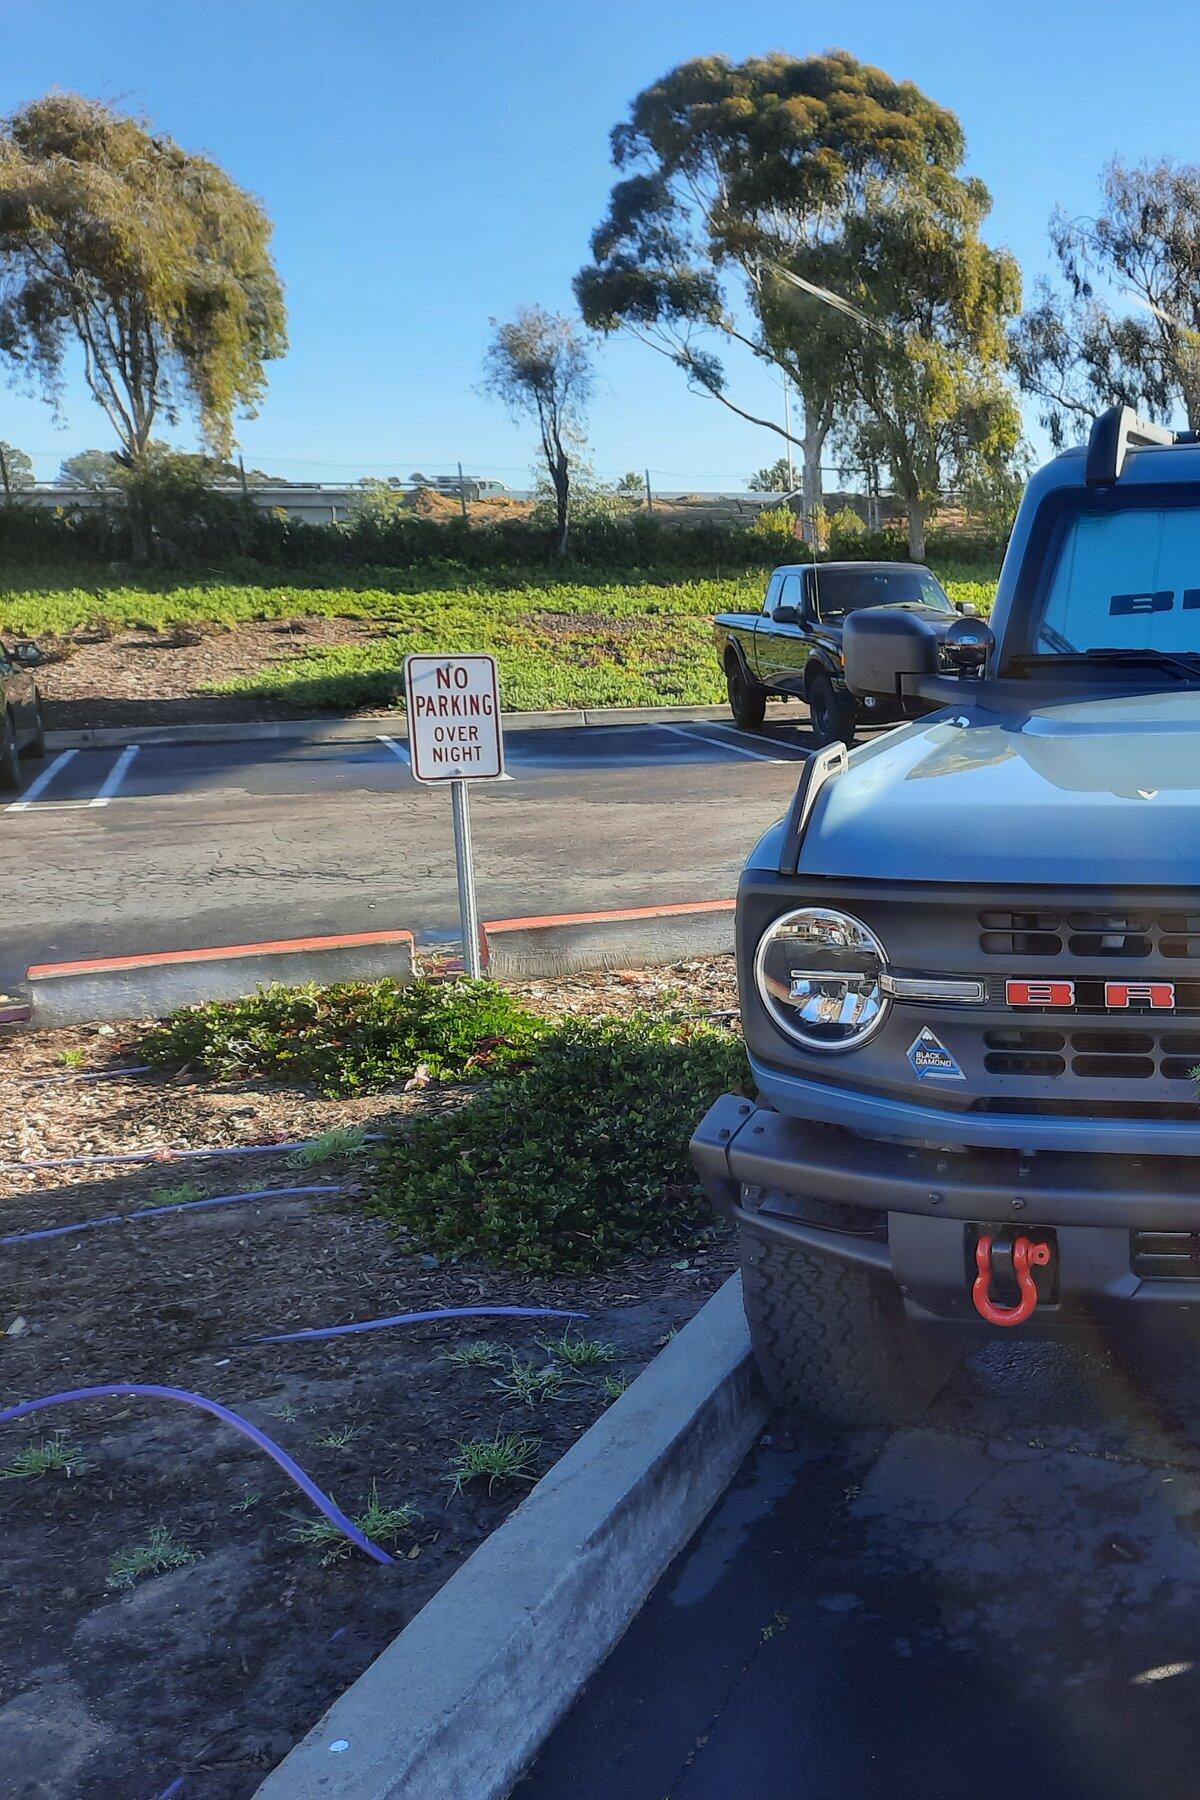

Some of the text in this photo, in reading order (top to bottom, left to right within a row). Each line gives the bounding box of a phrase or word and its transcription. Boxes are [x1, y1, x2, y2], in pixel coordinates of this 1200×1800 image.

[436, 667, 468, 689] NO
[415, 694, 492, 717] PARKING
[434, 726, 478, 742] OVER
[432, 746, 482, 762] NIGHT
[915, 1051, 940, 1059] BLACK
[915, 1058, 952, 1067] DIAMOND
